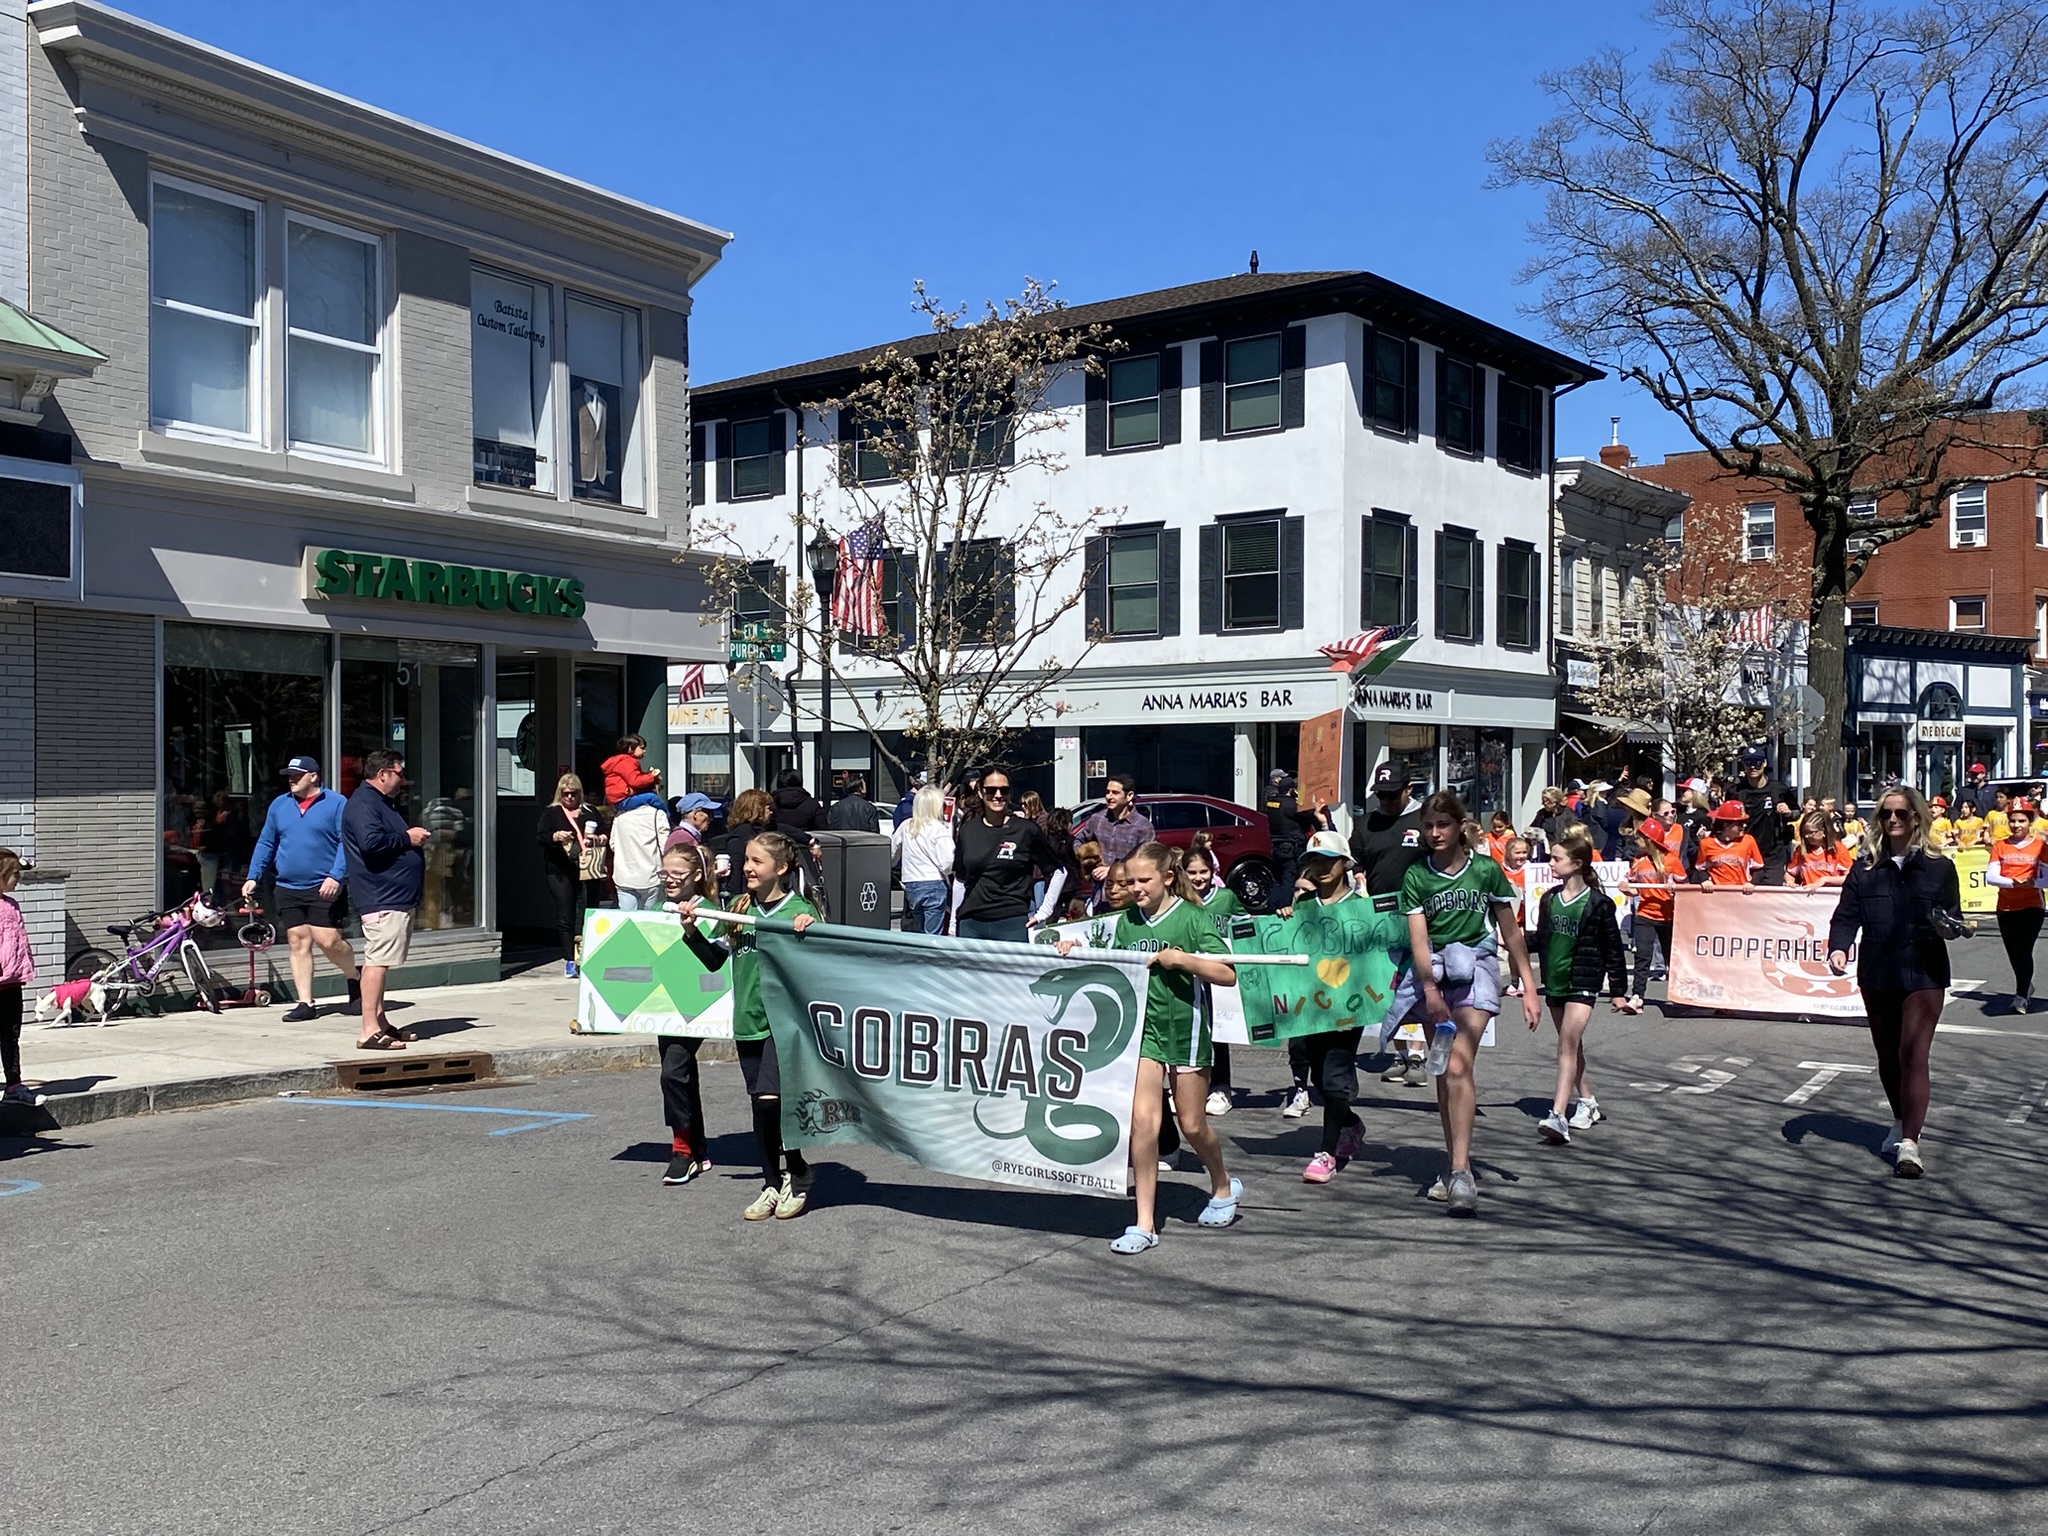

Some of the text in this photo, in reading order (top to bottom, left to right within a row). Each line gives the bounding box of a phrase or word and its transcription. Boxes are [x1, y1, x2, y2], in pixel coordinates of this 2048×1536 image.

[494, 300, 528, 321] Batista
[477, 313, 546, 349] Custom Tailoring
[314, 550, 586, 618] STARBUCKS
[396, 659, 422, 686] 51
[1141, 689, 1293, 711] ANNA MARIA'S BAR
[1415, 693, 1433, 711] BAR
[669, 707, 698, 726] WINE
[702, 707, 718, 725] AT
[1921, 725, 1933, 737] RYE
[1946, 726, 1962, 737] CARE
[1379, 769, 1392, 781] R
[1595, 865, 1620, 883] OU
[1423, 888, 1489, 918] COBRAS
[633, 1015, 656, 1034] GO
[808, 1001, 1090, 1101] COBRAS
[819, 1099, 862, 1128] RYE
[991, 1159, 1117, 1191] @RYEGIRLSSOFTBALL
